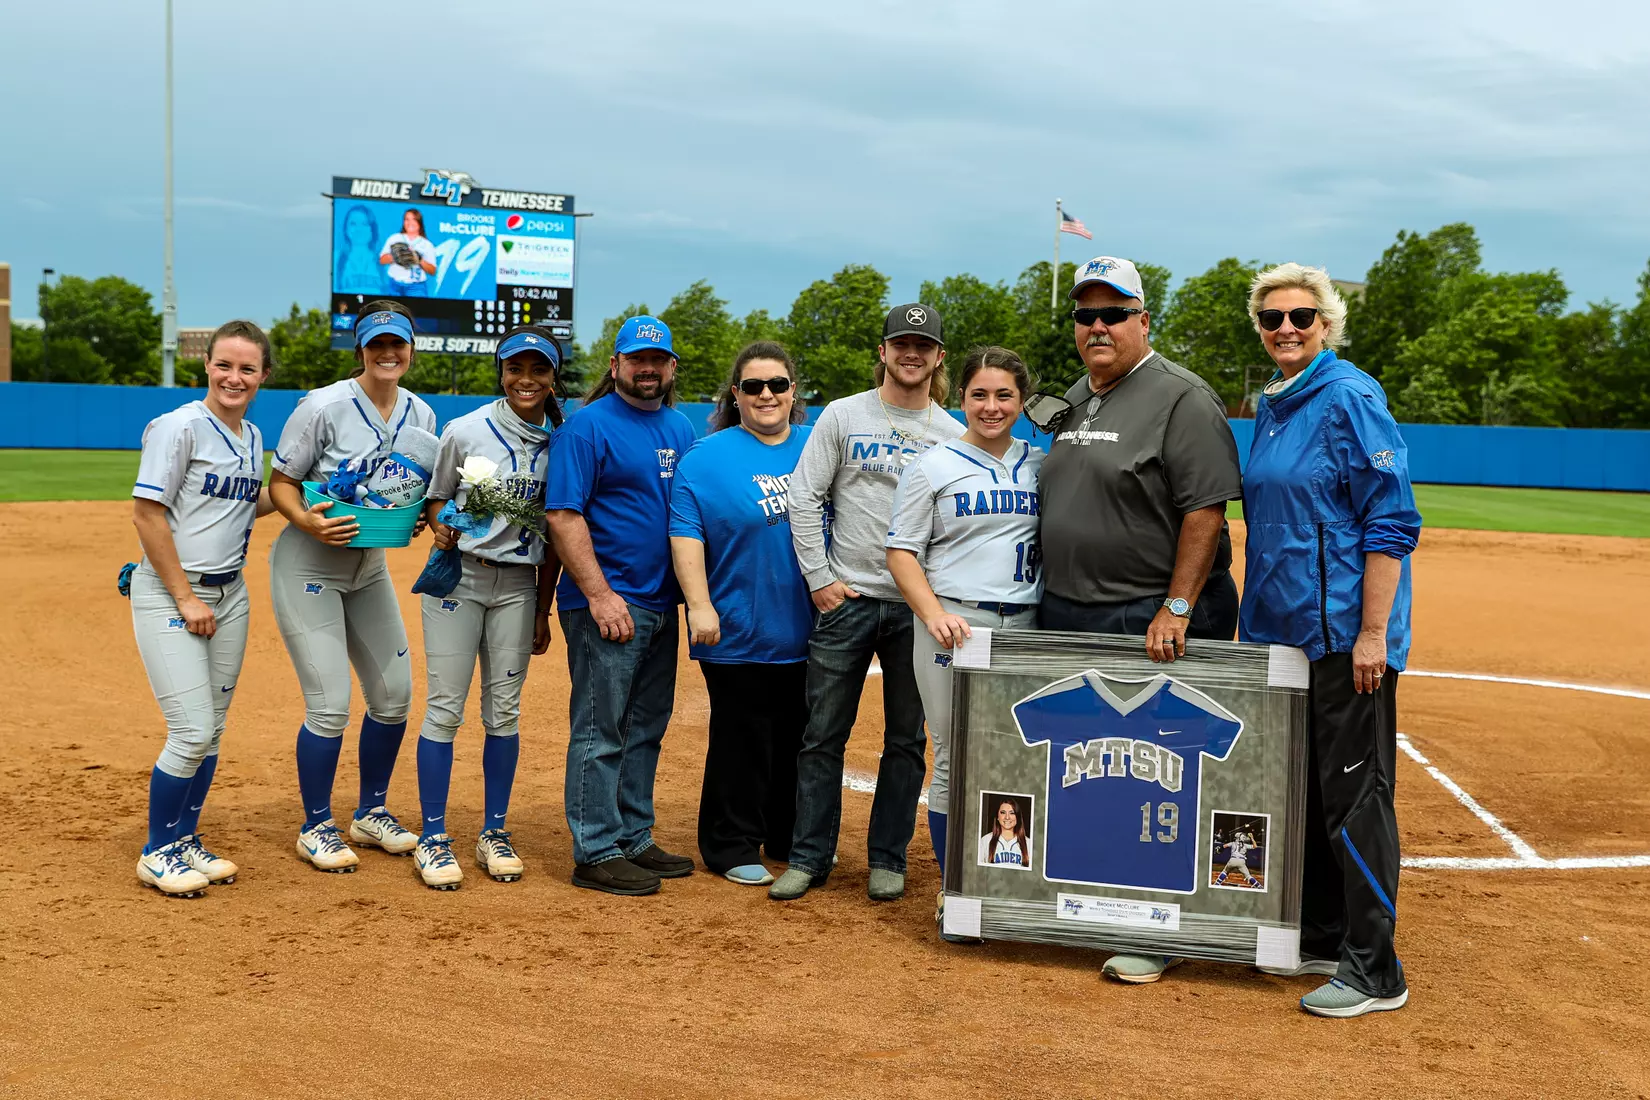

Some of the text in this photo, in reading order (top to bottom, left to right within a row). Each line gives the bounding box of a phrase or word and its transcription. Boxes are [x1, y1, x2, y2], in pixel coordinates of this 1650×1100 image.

[350, 180, 412, 199] MIDDLE
[421, 171, 463, 206] MT
[481, 189, 565, 211] TENNESSEE
[456, 213, 496, 224] BROOKE
[526, 219, 564, 233] pepsi
[439, 222, 496, 236] McCLURE
[512, 287, 558, 300] 10:42 AM
[636, 324, 664, 343] MT
[381, 461, 411, 482] MT
[861, 463, 885, 473] BLUE
[376, 487, 401, 496] Brooke
[403, 492, 411, 501] 19
[1062, 737, 1184, 793] MTSU
[1139, 801, 1179, 843] 19
